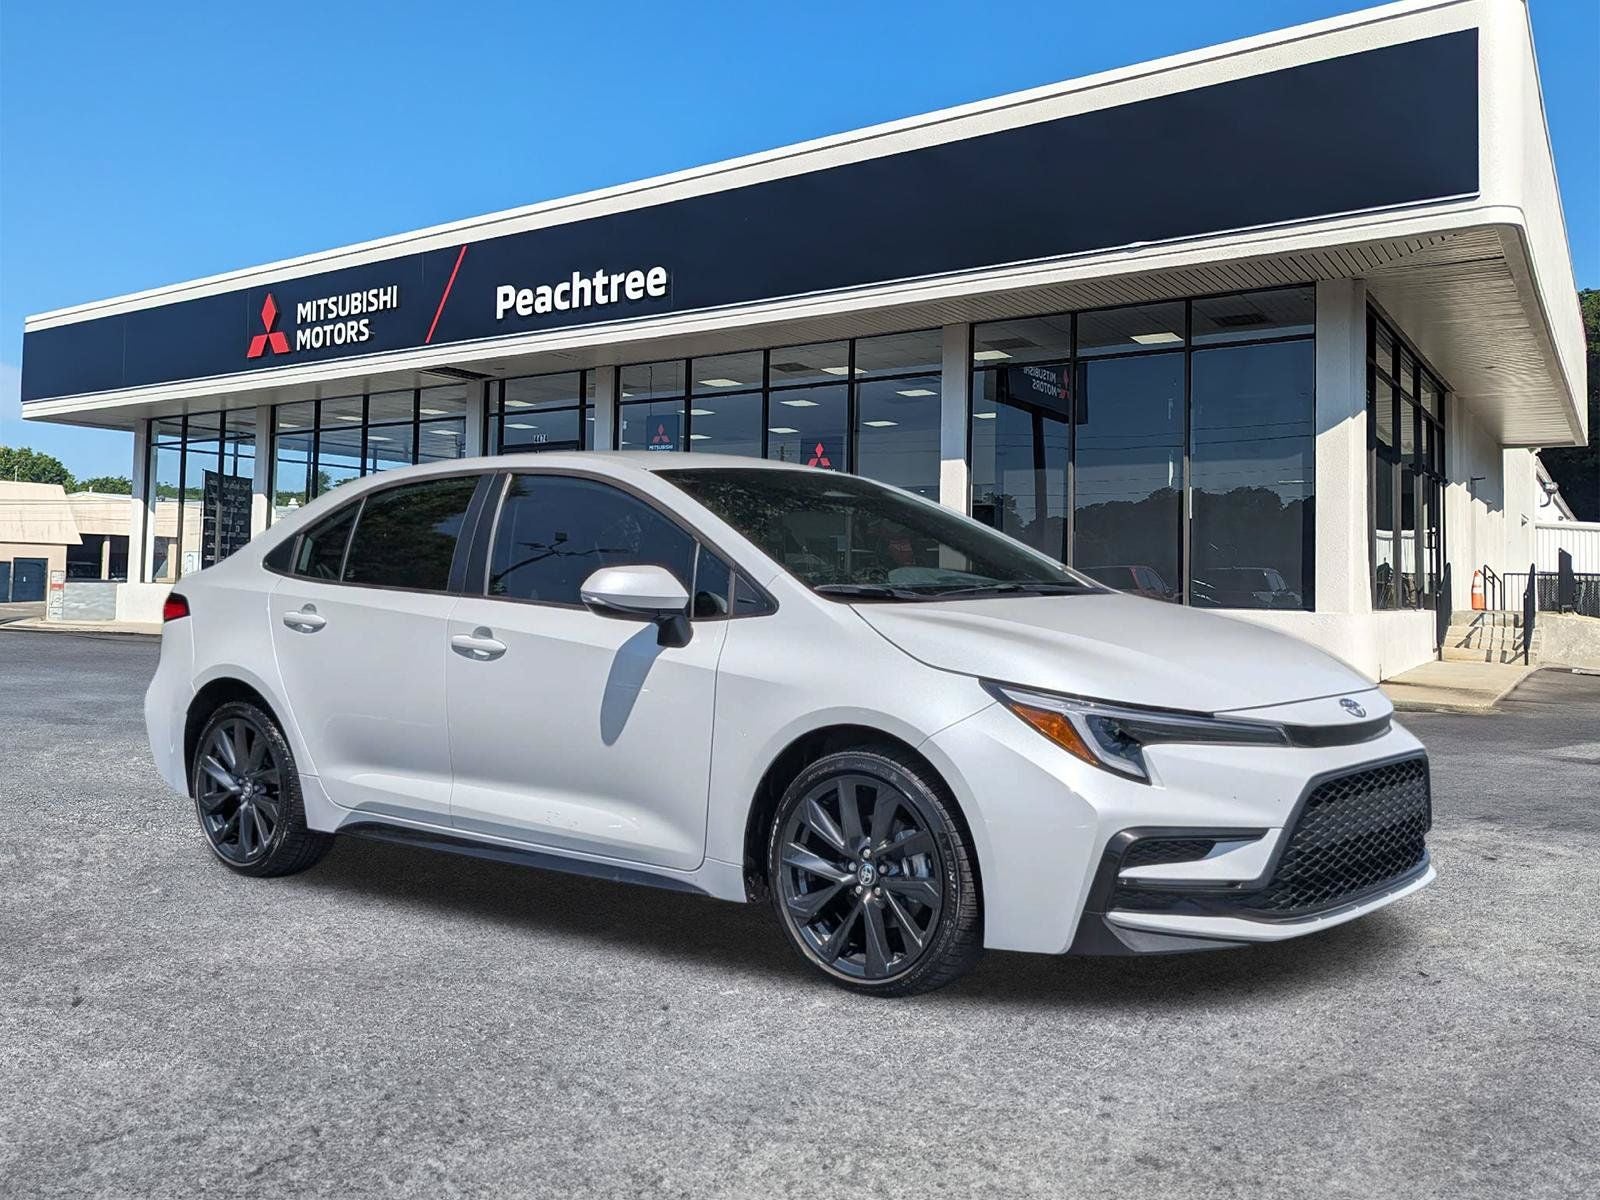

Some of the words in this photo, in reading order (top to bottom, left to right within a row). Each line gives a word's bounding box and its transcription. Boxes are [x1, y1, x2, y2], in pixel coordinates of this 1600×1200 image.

[296, 285, 398, 324] MITSUBISHI
[496, 266, 667, 319] Peachtree
[296, 318, 370, 351] MOTORS
